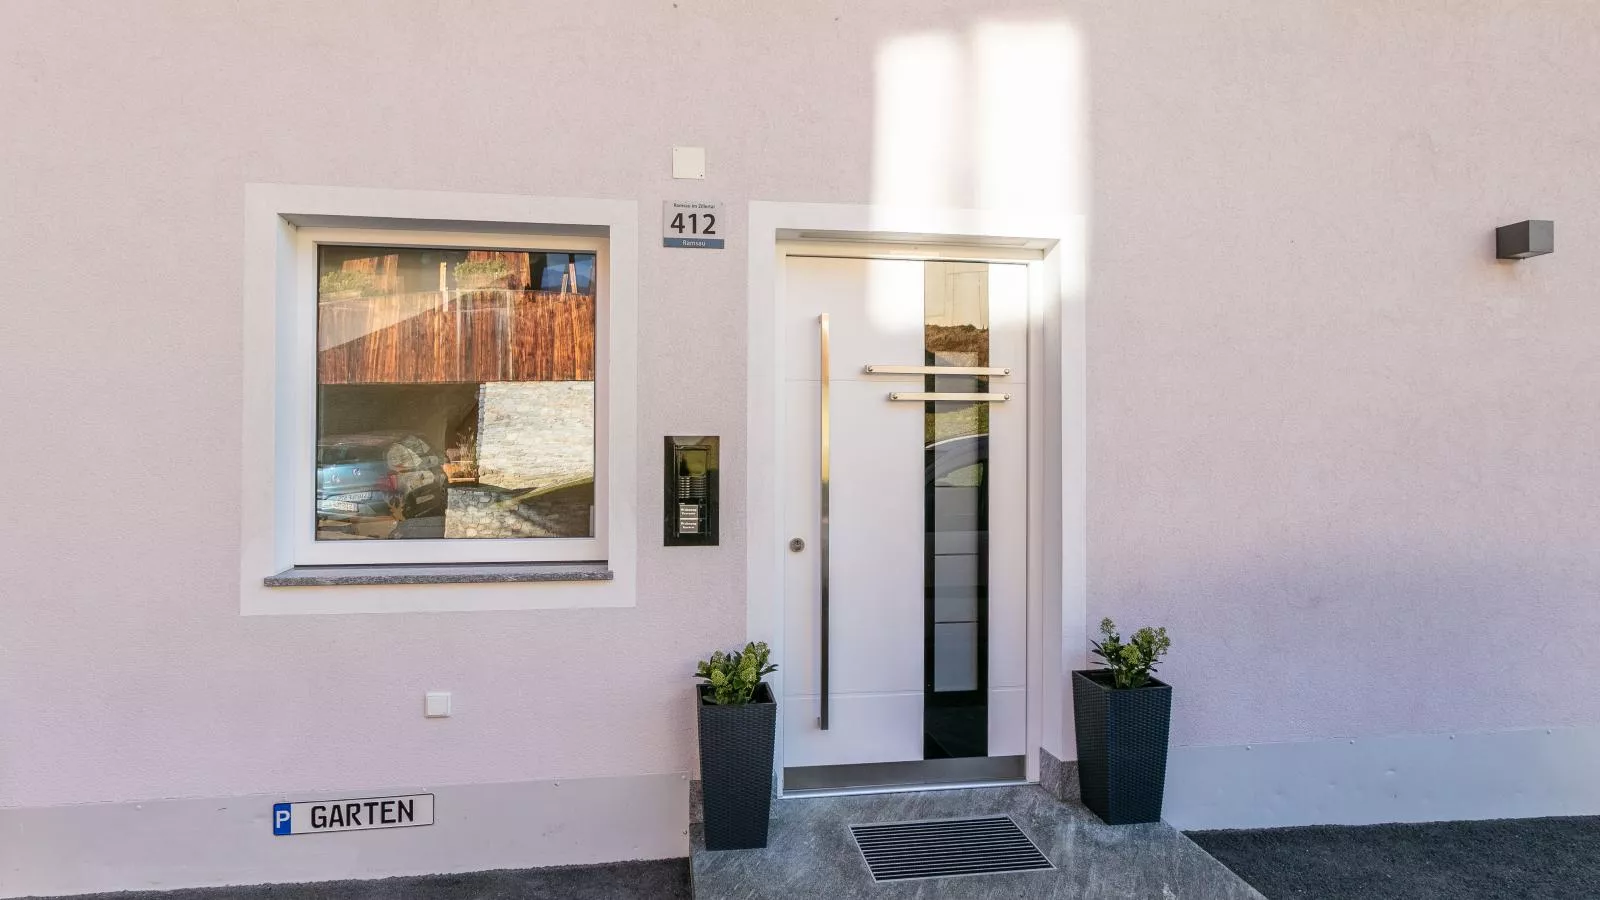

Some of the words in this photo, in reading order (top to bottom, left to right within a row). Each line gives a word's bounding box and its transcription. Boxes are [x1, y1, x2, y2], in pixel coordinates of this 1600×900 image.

[670, 212, 716, 235] 412
[276, 810, 291, 829] P
[311, 799, 414, 829] GARTEN
